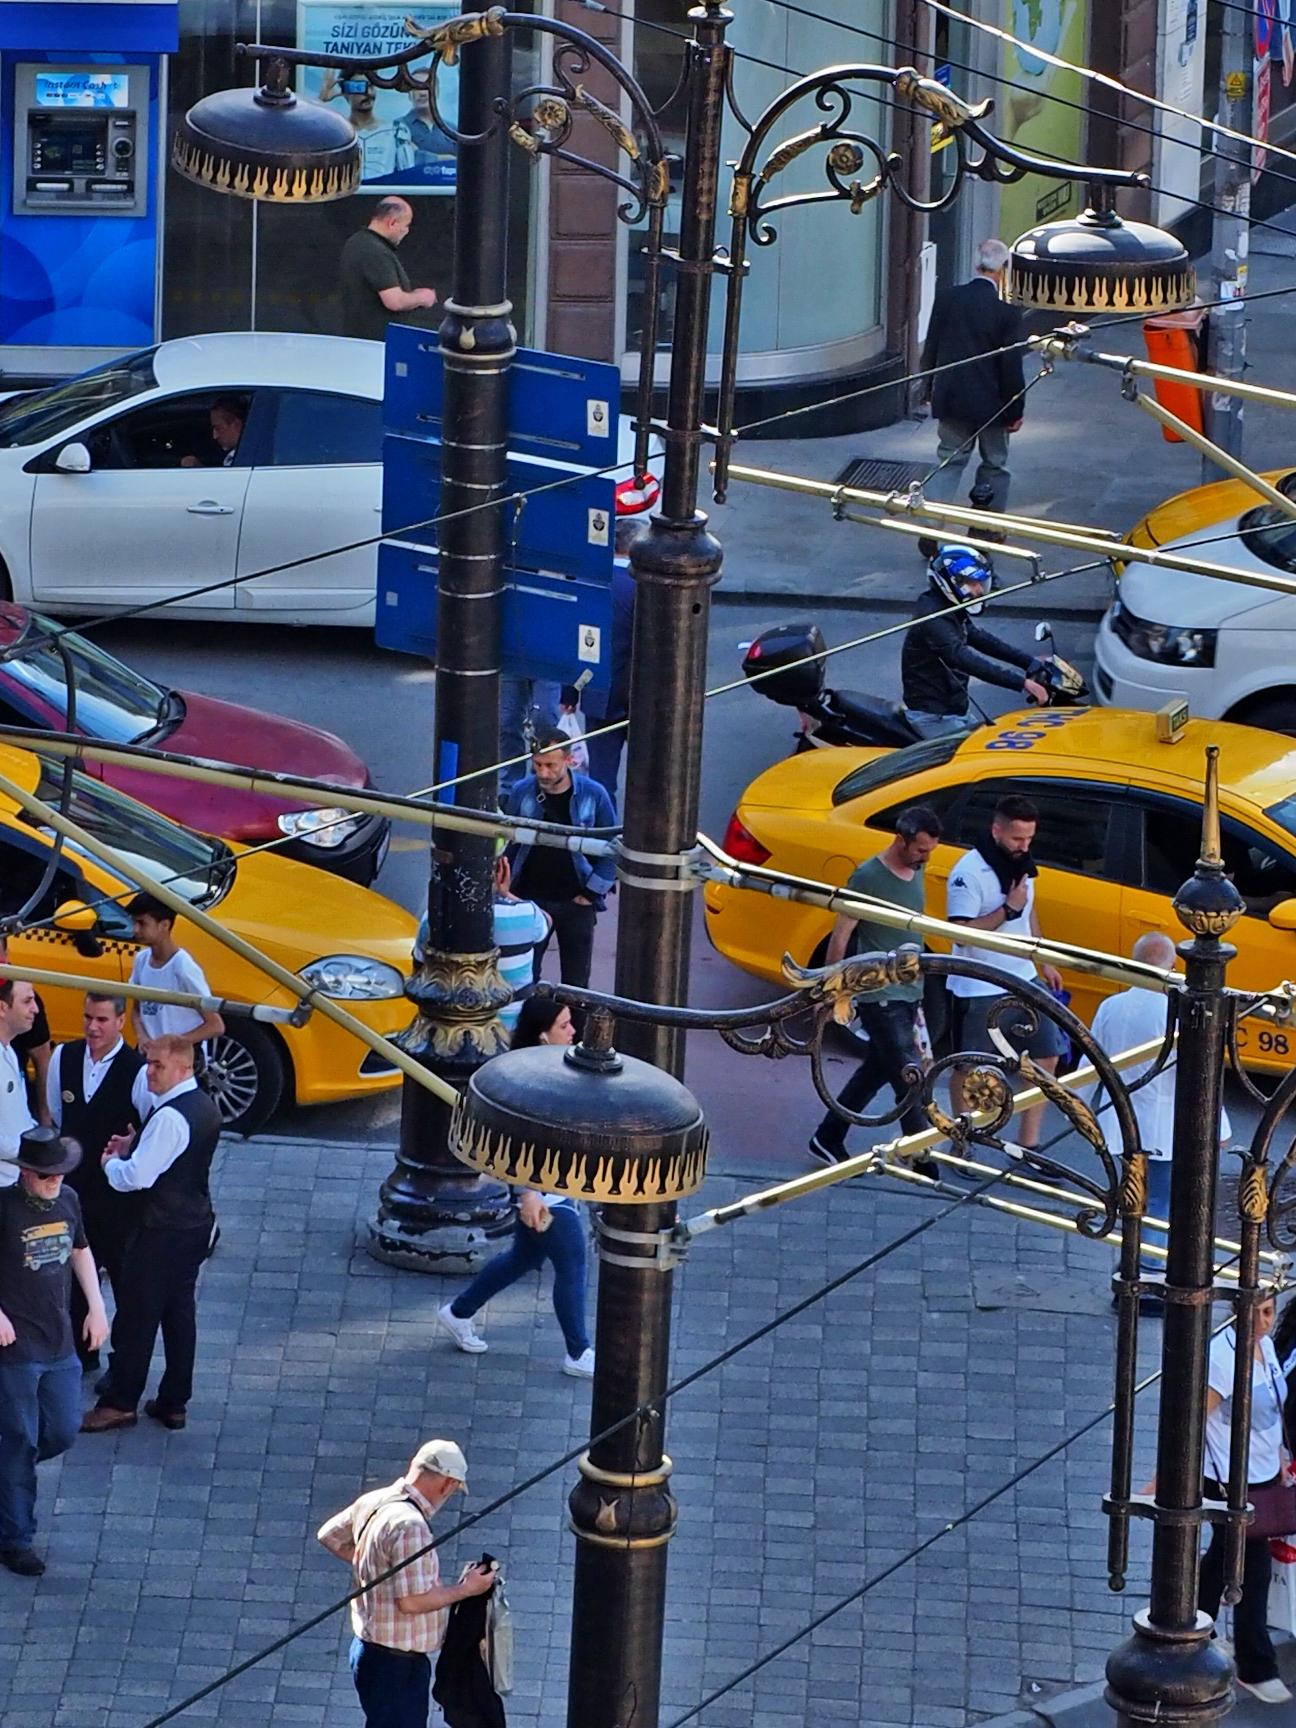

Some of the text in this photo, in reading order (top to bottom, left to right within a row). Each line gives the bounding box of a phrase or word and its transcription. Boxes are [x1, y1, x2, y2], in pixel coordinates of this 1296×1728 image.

[331, 22, 417, 39] SİZİ GÖZÜN
[324, 41, 416, 55] TANIYAN TEK
[985, 730, 1047, 750] 98
[1258, 1031, 1290, 1056] 98
